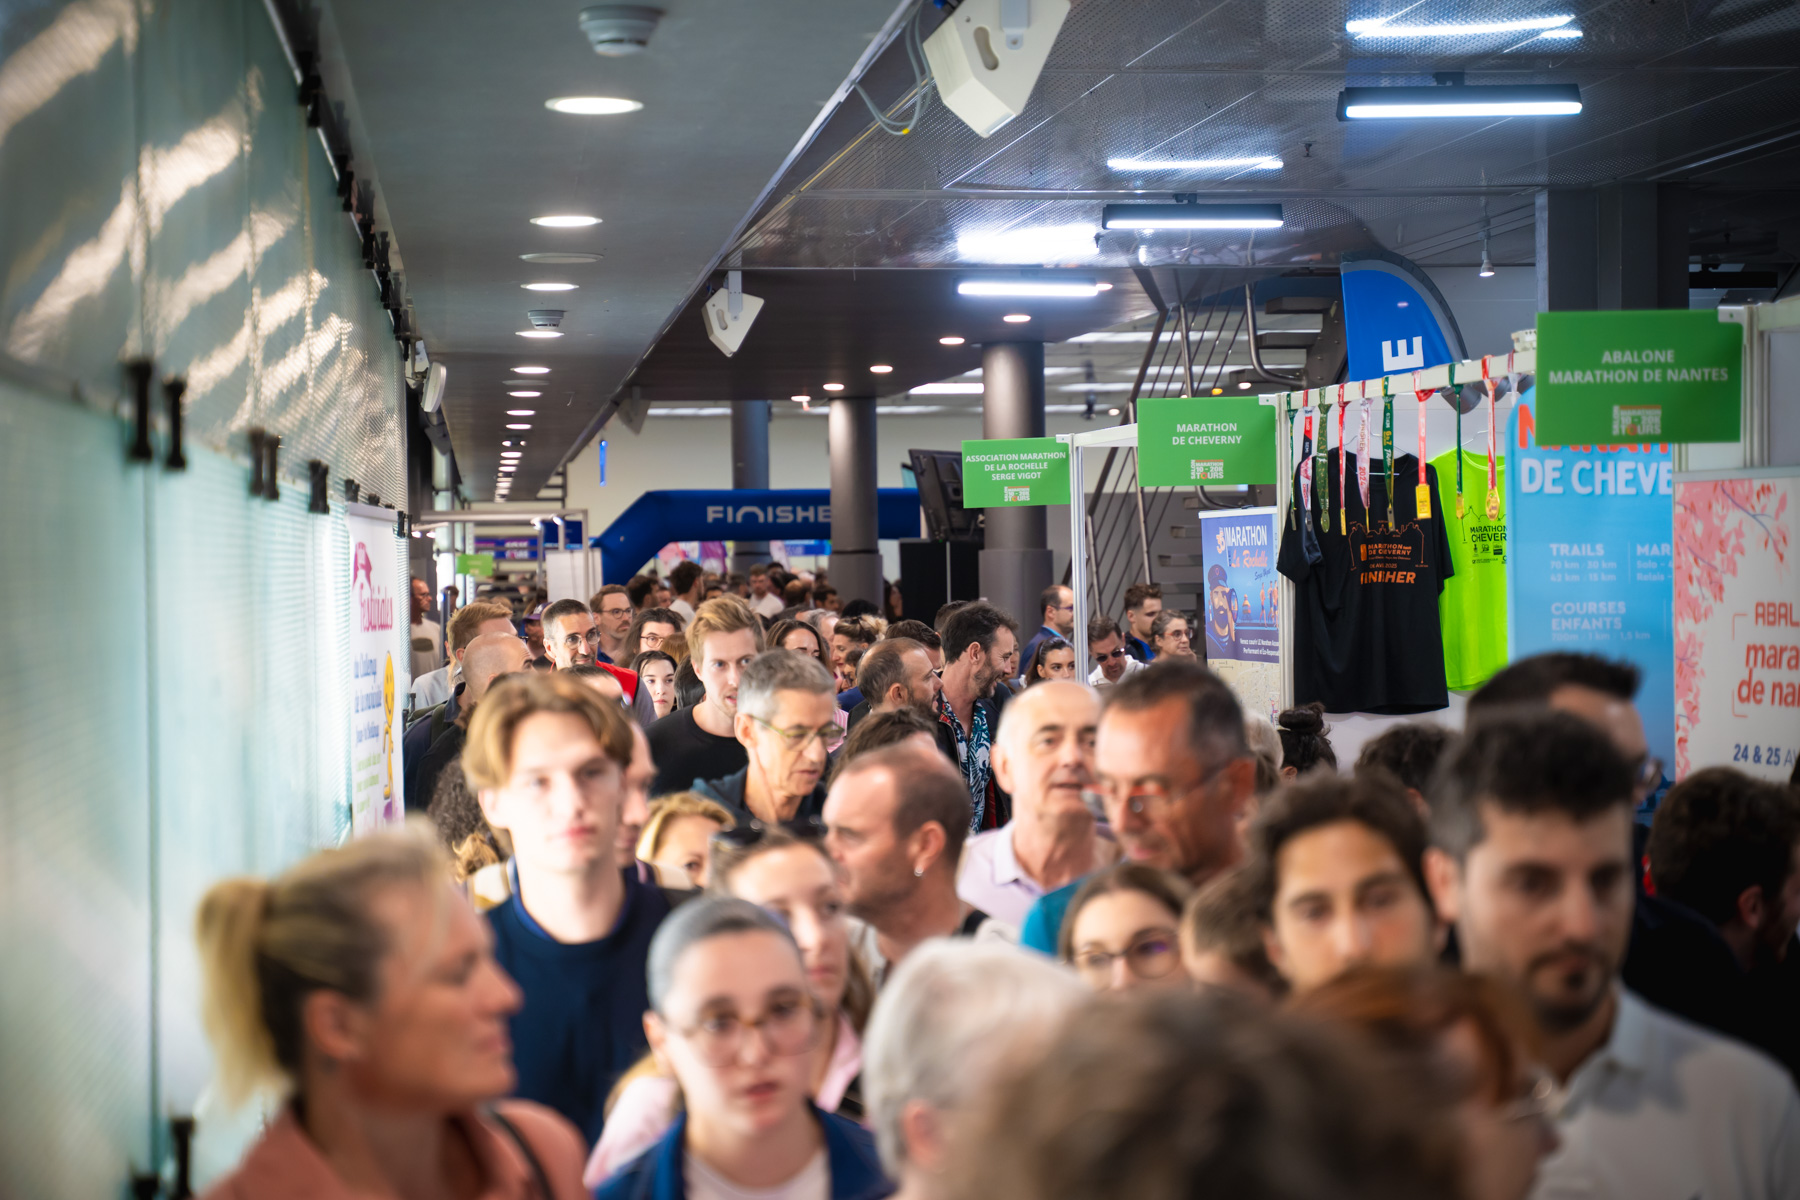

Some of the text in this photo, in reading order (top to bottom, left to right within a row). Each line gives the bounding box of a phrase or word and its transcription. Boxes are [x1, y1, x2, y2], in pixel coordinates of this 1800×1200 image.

[1601, 350, 1675, 364] ABALONE
[1549, 368, 1729, 384] MARATHON DE NANTES
[1176, 423, 1237, 433] MARATHON
[1620, 424, 1662, 436] TOURS
[1172, 435, 1242, 445] DE CHEVERNY
[965, 452, 1066, 463] ASSOCIATION MARATHON
[996, 463, 1007, 471] LA
[1008, 462, 1048, 470] ROCHELLE
[991, 471, 1042, 481] SERGE VIGOT
[1196, 472, 1224, 480] TOURS
[1359, 466, 1367, 486] 2024
[1520, 458, 1672, 495] DE CHEVE
[706, 505, 831, 523] FINISHE
[1226, 525, 1267, 547] MARATHON
[1549, 543, 1605, 556] TRAILS
[1636, 543, 1671, 556] MAR
[1242, 548, 1268, 568] Rochelle
[1564, 560, 1580, 569] km
[1601, 560, 1617, 569] km
[1636, 560, 1658, 569] Solo
[1565, 572, 1580, 581] km
[1602, 572, 1617, 581] km
[1636, 572, 1665, 581] Relais
[1550, 602, 1626, 615] COURSES
[1755, 601, 1800, 627] ABAL
[1551, 617, 1622, 630] ENFANTS
[1635, 631, 1651, 640] km
[1745, 643, 1799, 671] mara
[1737, 667, 1765, 706] de
[1733, 743, 1749, 763] 24
[1753, 745, 1762, 764] &
[1766, 746, 1781, 767] 25
